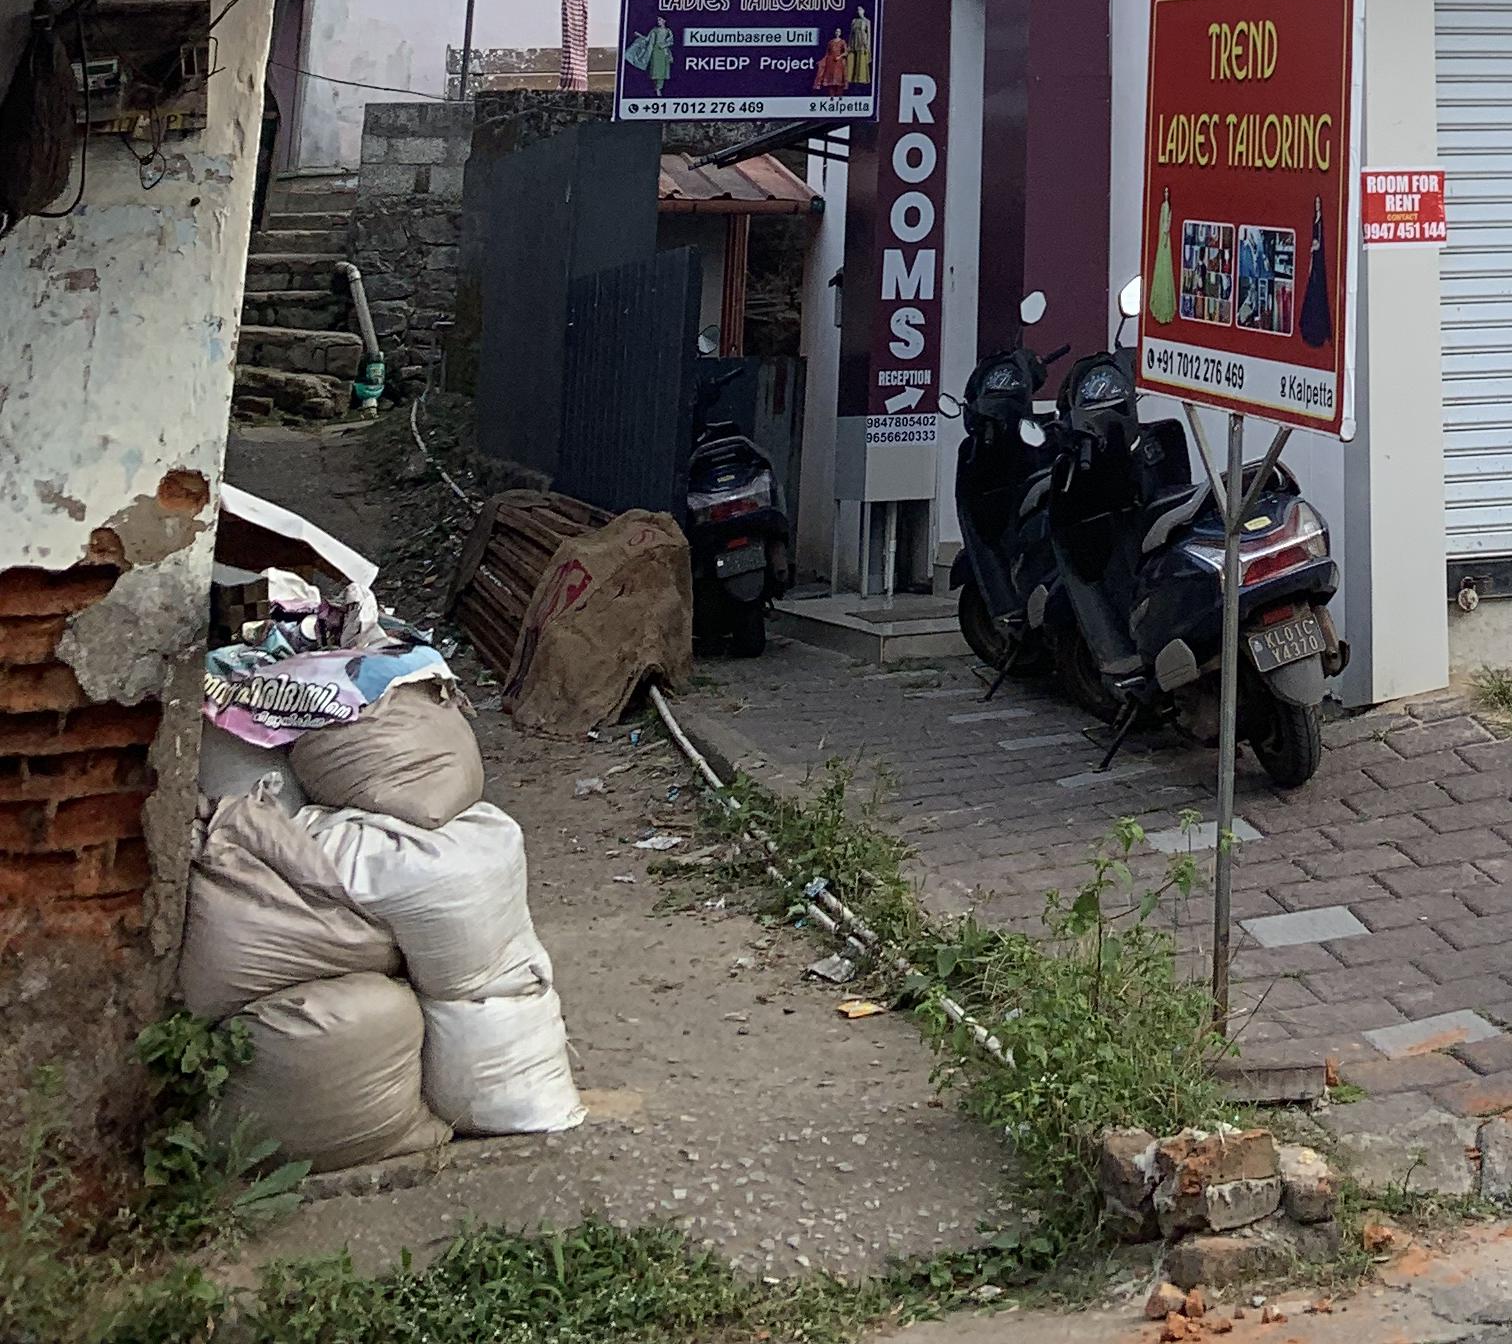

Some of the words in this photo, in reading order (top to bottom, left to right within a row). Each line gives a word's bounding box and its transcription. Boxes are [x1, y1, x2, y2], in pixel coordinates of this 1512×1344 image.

[690, 31, 781, 44] Kudumbasree
[787, 30, 813, 43] Unit
[1209, 20, 1278, 80] TREND
[686, 57, 750, 70] RKIEDP
[760, 56, 814, 73] Project
[642, 103, 667, 114] +91
[673, 102, 706, 114] 7012
[711, 102, 735, 113] 276
[739, 102, 764, 113] 469
[819, 100, 869, 115] Kalpetta
[1158, 113, 1217, 166] LADIES
[1226, 113, 1332, 171] TAILORING
[1366, 175, 1409, 193] ROOM
[1412, 174, 1439, 192] FOR
[1385, 194, 1421, 212] RENT
[881, 73, 938, 360] ROOMS
[1387, 213, 1418, 221] CONTACT
[1363, 222, 1395, 240] 9947
[1397, 222, 1420, 239] 451
[1422, 221, 1446, 239] 144
[878, 369, 932, 386] RECEPTION
[1157, 349, 1174, 374] +91
[1177, 352, 1200, 381] 7012
[1203, 358, 1222, 385] 276
[1224, 362, 1244, 389] 469
[1289, 374, 1333, 409] Kalpetta
[866, 415, 937, 428] 9847805402
[866, 430, 936, 443] 9656620333
[1264, 619, 1314, 648] KL01C
